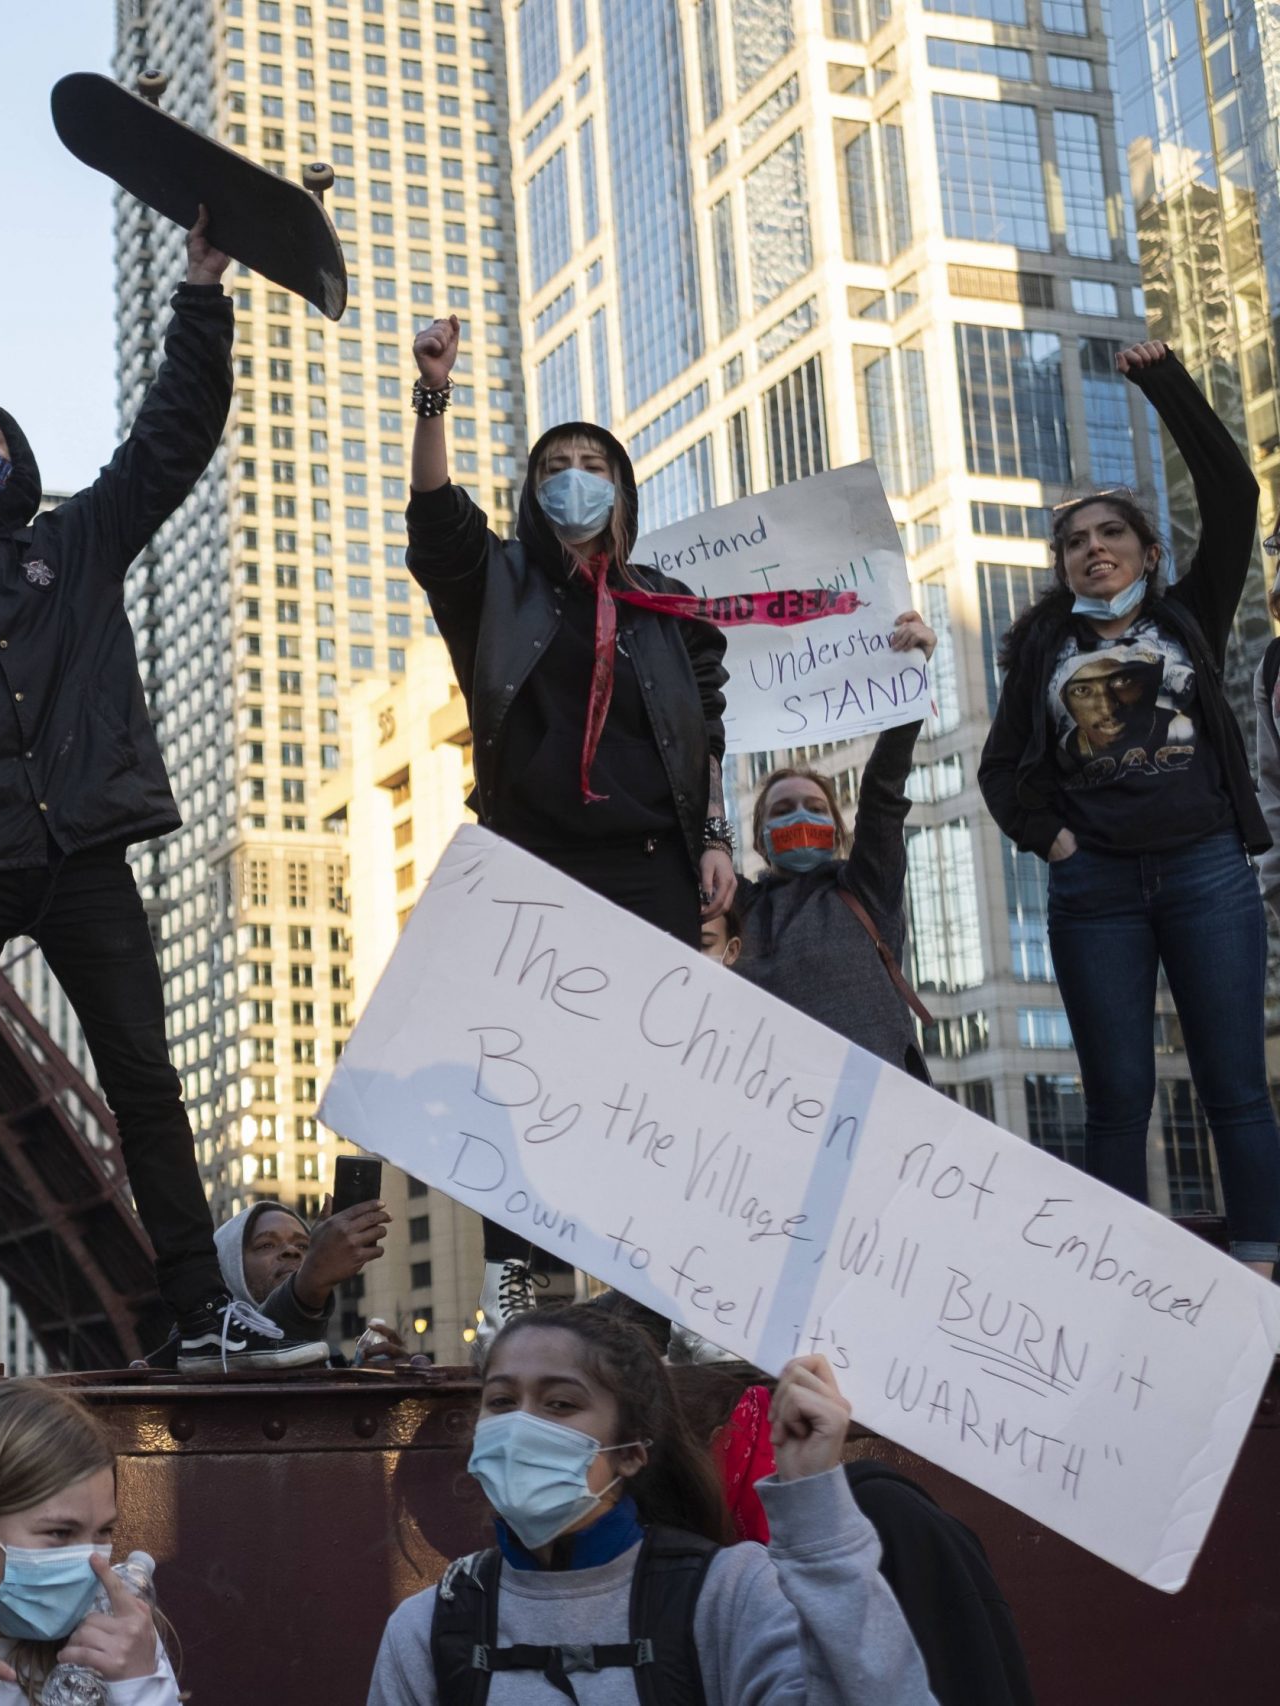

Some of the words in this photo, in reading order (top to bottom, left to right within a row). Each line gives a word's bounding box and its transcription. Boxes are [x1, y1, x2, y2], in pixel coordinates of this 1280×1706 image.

[646, 515, 768, 573] derstand
[697, 593, 755, 621] OUT
[749, 626, 898, 692] Understan
[467, 1026, 582, 1144] By
[602, 1083, 675, 1168] the
[839, 1216, 920, 1298] Will
[939, 1266, 1089, 1385] BURN
[1113, 1353, 1154, 1412] it
[638, 965, 858, 1161] Children
[897, 1142, 999, 1220] not
[1021, 1197, 1218, 1327] Embraced
[447, 1131, 578, 1243] Down
[606, 1216, 651, 1270] to
[669, 1245, 764, 1340] feel
[791, 1315, 851, 1370] it's
